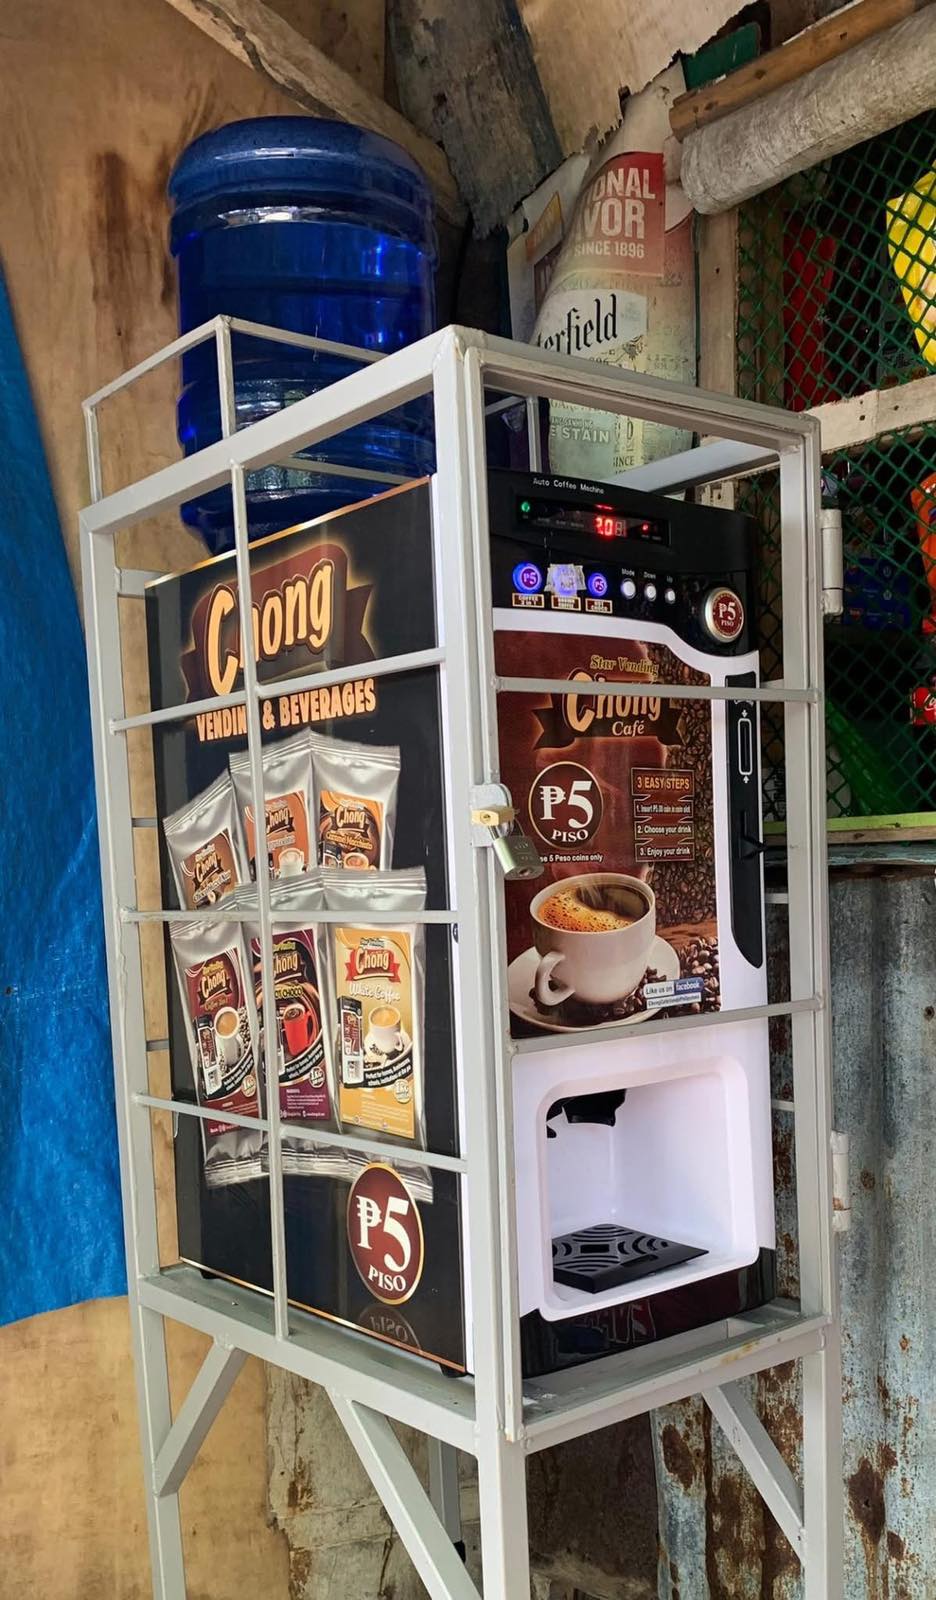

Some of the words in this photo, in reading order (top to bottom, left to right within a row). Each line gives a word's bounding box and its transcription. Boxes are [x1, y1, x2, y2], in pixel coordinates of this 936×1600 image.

[574, 241, 611, 256] SINCE
[614, 242, 645, 259] 1896
[562, 427, 610, 443] STAIN
[532, 477, 550, 487] Auto
[553, 479, 577, 490] Coffee
[590, 654, 617, 670] Star
[617, 656, 660, 676] Vending
[262, 700, 276, 731] &
[279, 677, 377, 728] BEVERAGES
[611, 720, 645, 737] Café
[637, 776, 642, 788] 3
[644, 776, 665, 789] EASY
[666, 778, 690, 790] STEPS
[336, 805, 366, 829] Chong
[551, 829, 589, 843] PISO
[637, 826, 643, 834] 2.
[644, 825, 665, 834] Choose
[665, 827, 676, 836] your
[677, 825, 691, 833] drink
[549, 854, 554, 862] 5
[555, 854, 572, 862] Peso
[572, 853, 589, 862] coins
[590, 853, 603, 863] only
[647, 847, 662, 857] Enjoy
[663, 849, 675, 857] your
[676, 847, 690, 855] drink
[355, 947, 390, 975] Chong
[201, 969, 227, 999] Chong
[646, 986, 658, 995] Like
[675, 980, 700, 991] facebook
[367, 1264, 406, 1292] PISO
